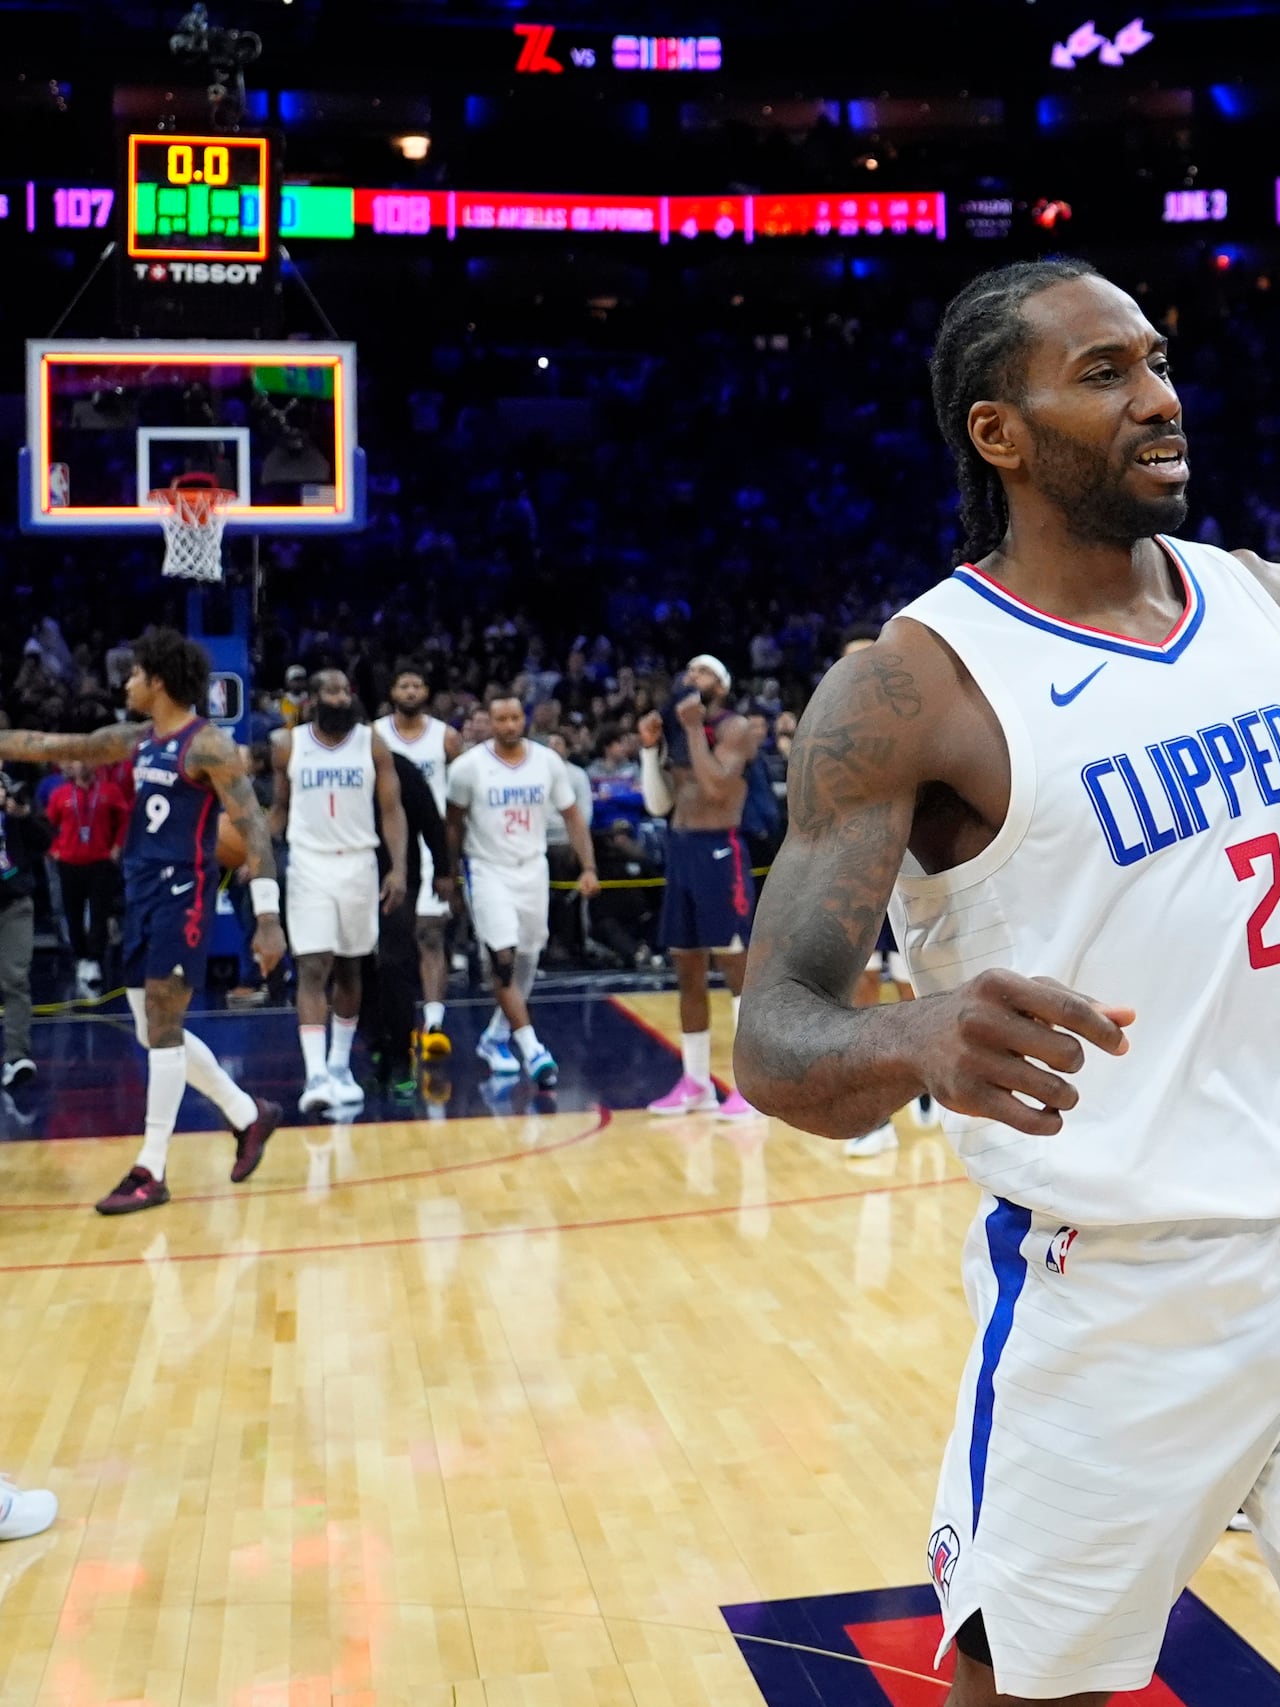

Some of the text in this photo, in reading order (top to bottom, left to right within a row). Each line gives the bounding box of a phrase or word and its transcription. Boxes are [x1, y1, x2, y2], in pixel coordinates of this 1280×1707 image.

[168, 145, 229, 185] 0.0
[54, 188, 114, 228] 107
[168, 263, 262, 284] TISSOT
[301, 768, 364, 790] CLIPPERS
[329, 793, 336, 818] 1
[488, 784, 544, 808] CLIPPERS
[145, 794, 171, 833] 9
[504, 809, 531, 834] 24
